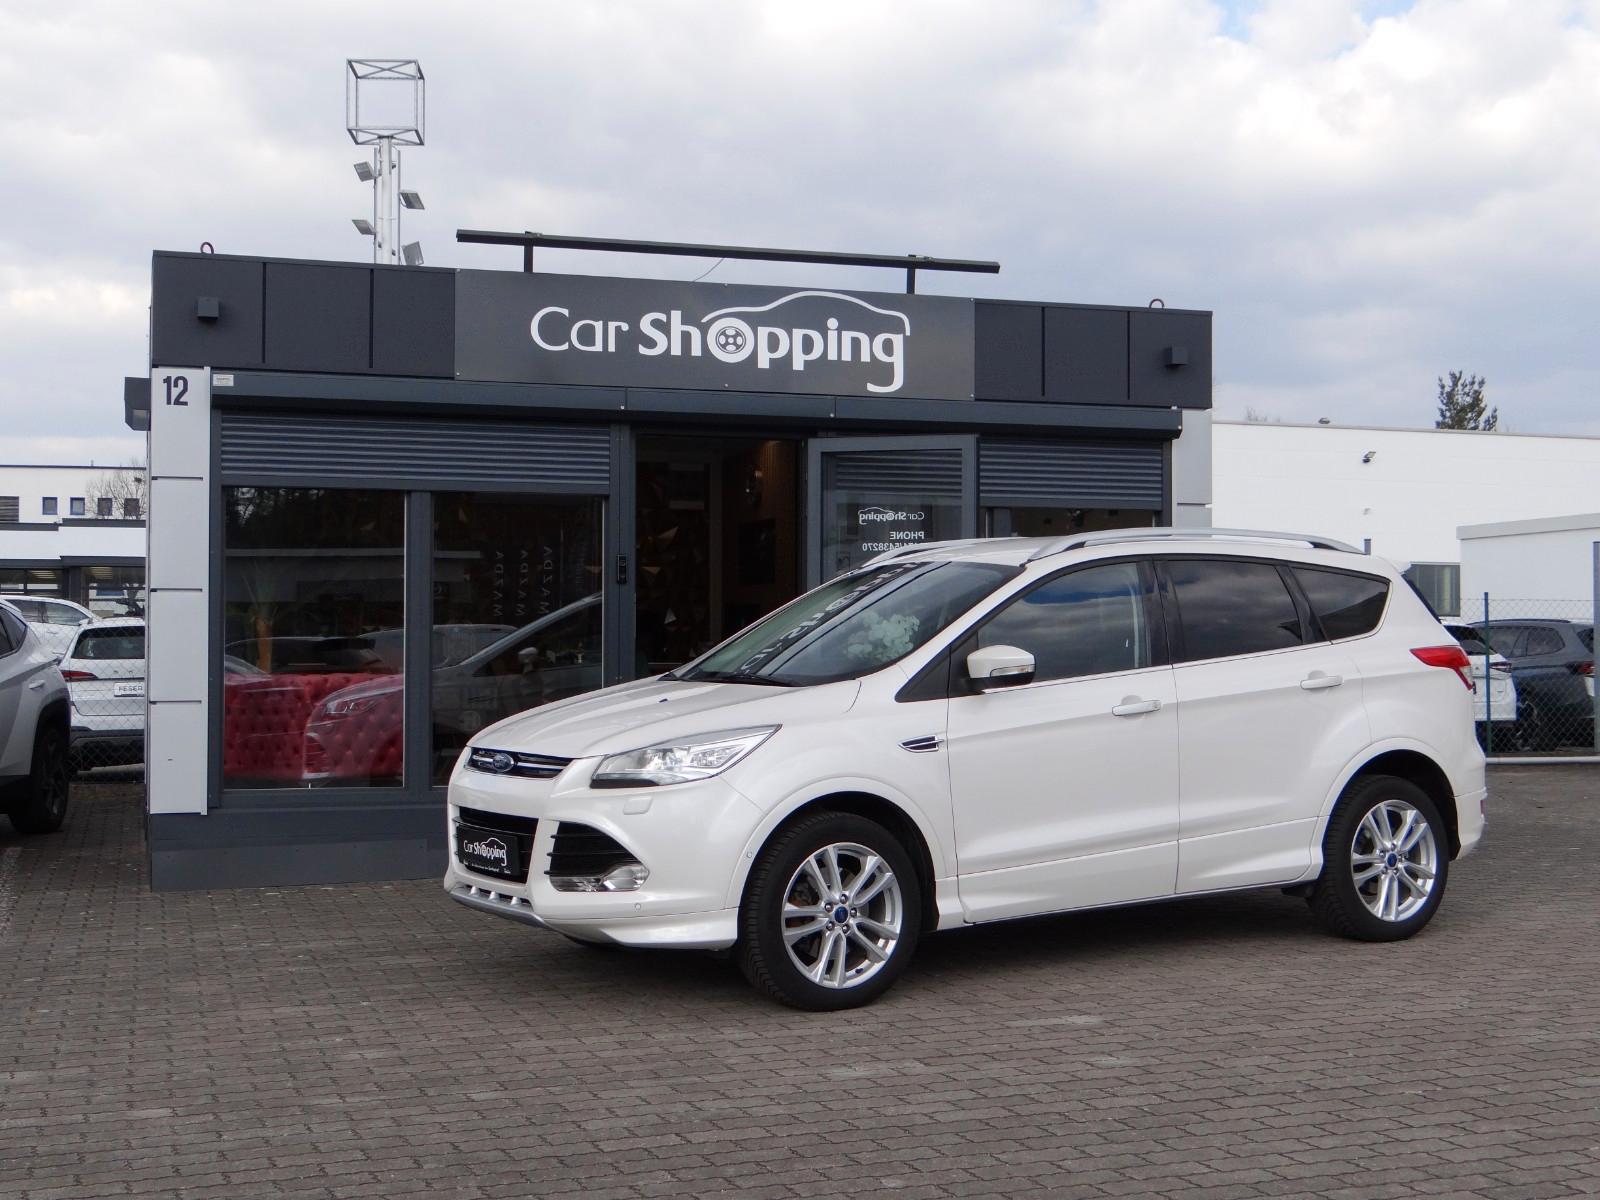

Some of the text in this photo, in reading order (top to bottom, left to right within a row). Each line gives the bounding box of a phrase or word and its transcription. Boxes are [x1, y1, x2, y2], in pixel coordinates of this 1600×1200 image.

[530, 306, 905, 393] Car Shopping
[163, 375, 189, 407] 12
[463, 840, 507, 866] Car Shopping
